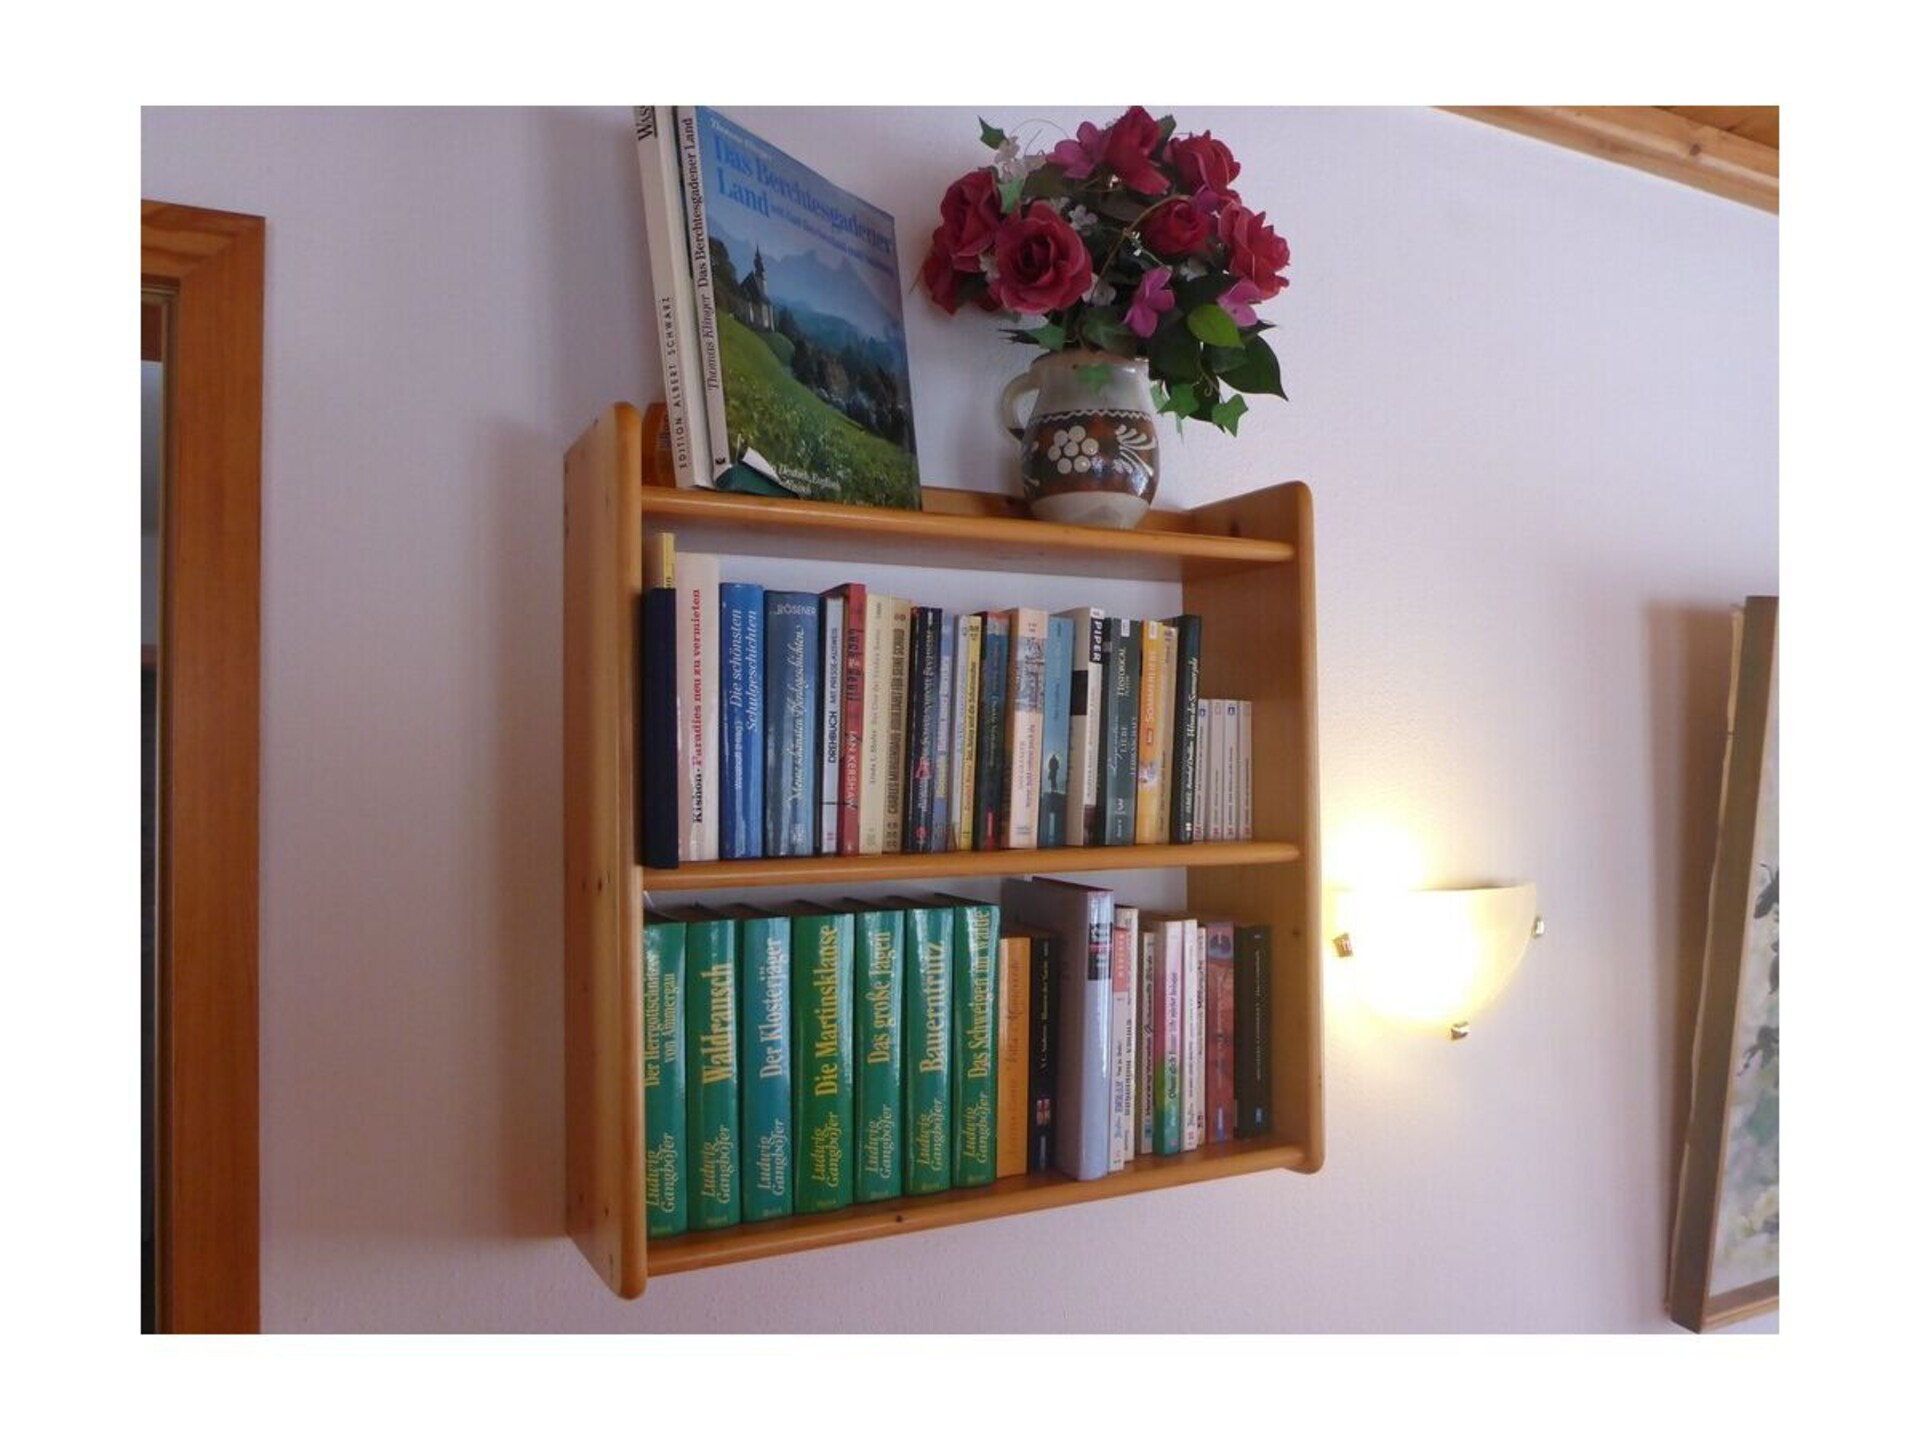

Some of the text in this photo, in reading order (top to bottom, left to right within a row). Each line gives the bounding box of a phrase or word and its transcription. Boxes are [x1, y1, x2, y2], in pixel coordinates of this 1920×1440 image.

[714, 132, 754, 176] Das
[755, 156, 892, 255] Berchtesgadener
[716, 166, 771, 218] Land
[681, 117, 720, 392] Thomas Klinger Das Berchtesgadener Land
[661, 297, 688, 469] EDITION ALBERT SCHWARZ
[690, 588, 702, 658] vermieten
[728, 609, 744, 709] Die schönsten
[1092, 619, 1102, 662] PIPER
[692, 659, 702, 676] zu
[692, 678, 702, 702] neu
[744, 609, 761, 734] Schulgeschichten
[690, 705, 703, 768] Paradies
[826, 710, 838, 764] DREHBUCH
[845, 755, 858, 811] KERSHAW
[660, 972, 680, 1063] von Ammergau
[699, 962, 734, 1086] Waldrausch
[758, 936, 788, 1080] Der Klosterjäger
[812, 924, 839, 1098] Die Martinsklause
[864, 931, 897, 1065] Das große Jagen
[918, 940, 946, 1074] Bauerntrutz
[965, 977, 995, 1050] Schweigen
[645, 1064, 660, 1088] Der
[967, 1052, 990, 1080] Das
[715, 1122, 736, 1205] Ganghofer
[756, 1135, 776, 1190] Ludwig
[770, 1116, 789, 1197] Ganghofer
[810, 1126, 830, 1181] Ludwig
[824, 1111, 843, 1188] Ganghofer
[864, 1118, 883, 1173] Ludwig
[876, 1103, 895, 1180] Ganghofer
[915, 1111, 934, 1166] Ludwig
[927, 1097, 946, 1172] Ganghofer
[962, 1104, 981, 1158] Ludwig
[973, 1090, 992, 1165] Ganghofer
[645, 1151, 663, 1207] Ludwig
[657, 1131, 679, 1214] Ganghofer
[699, 1141, 719, 1198] Ludwig
